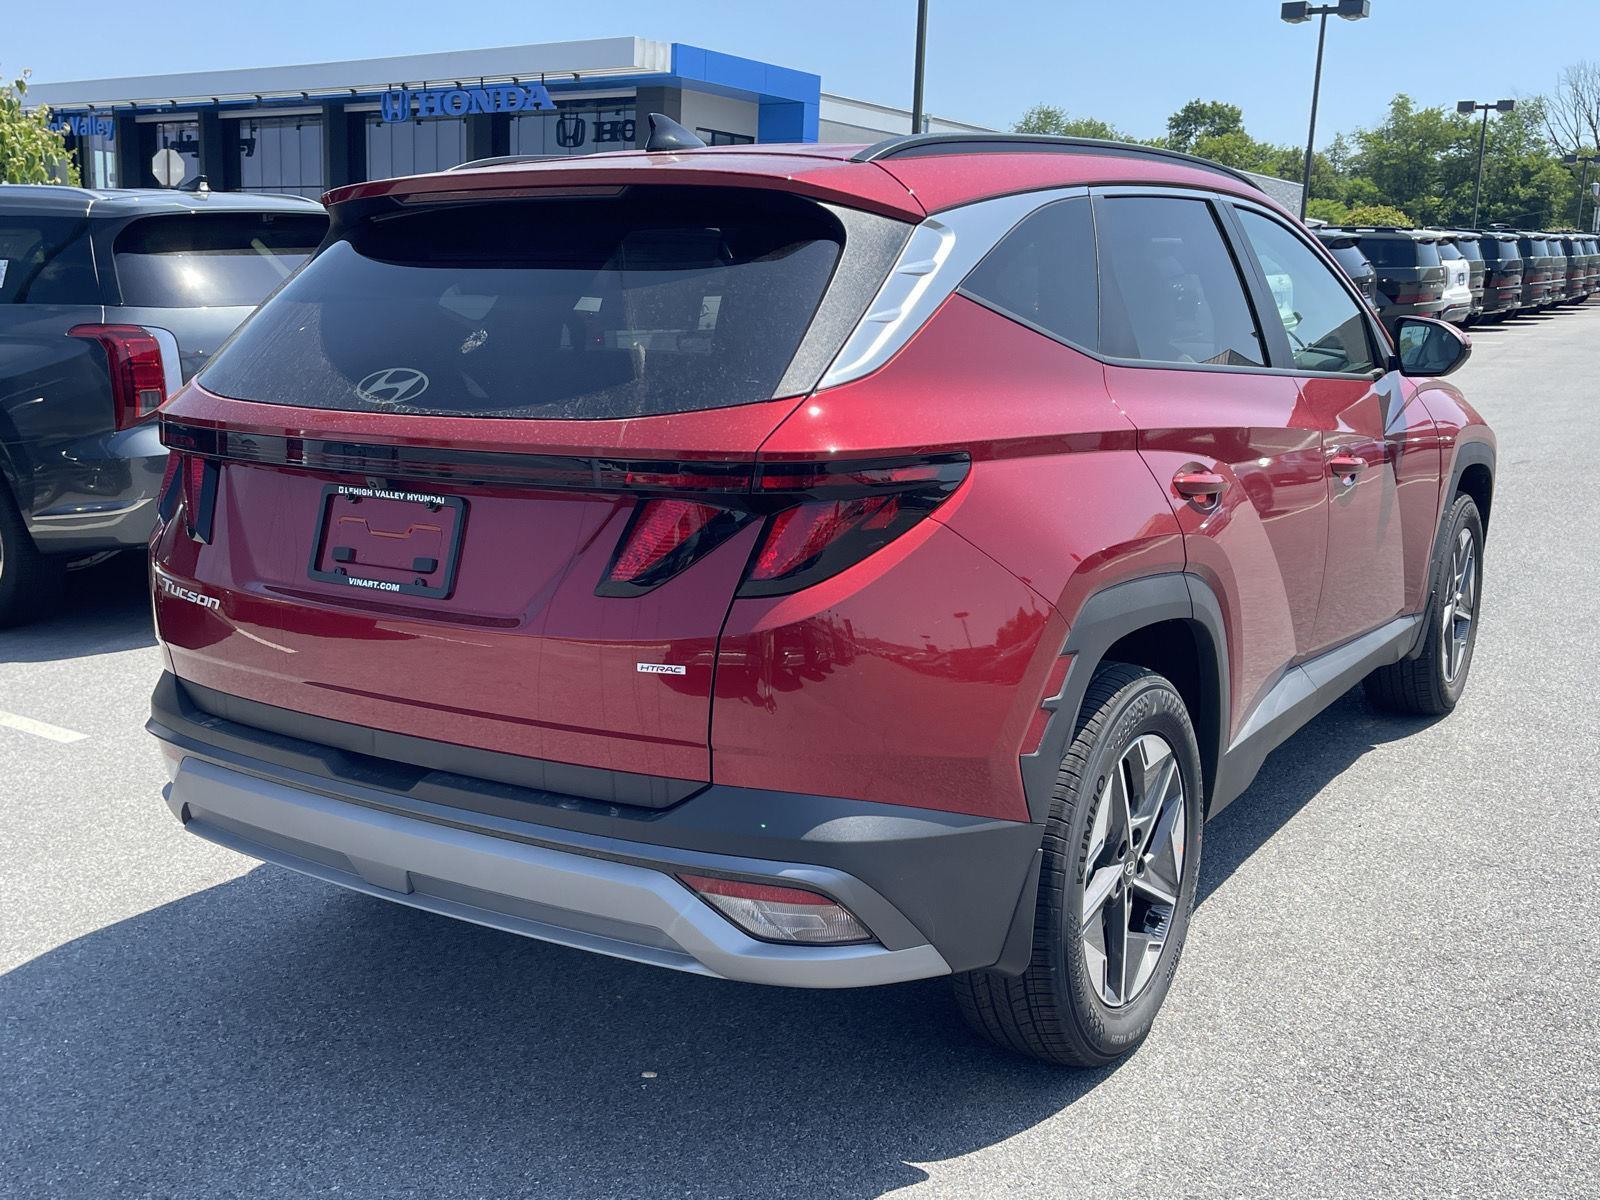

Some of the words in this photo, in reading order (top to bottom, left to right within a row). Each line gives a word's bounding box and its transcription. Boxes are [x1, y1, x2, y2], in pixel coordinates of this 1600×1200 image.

[416, 86, 558, 117] HONDA
[69, 114, 114, 140] Valley
[375, 490, 405, 500] VALLEY
[407, 493, 445, 504] HYUNDAI
[348, 577, 400, 592] VINART.COM
[640, 664, 682, 674] HTRAC
[1076, 774, 1106, 885] KUMHO
